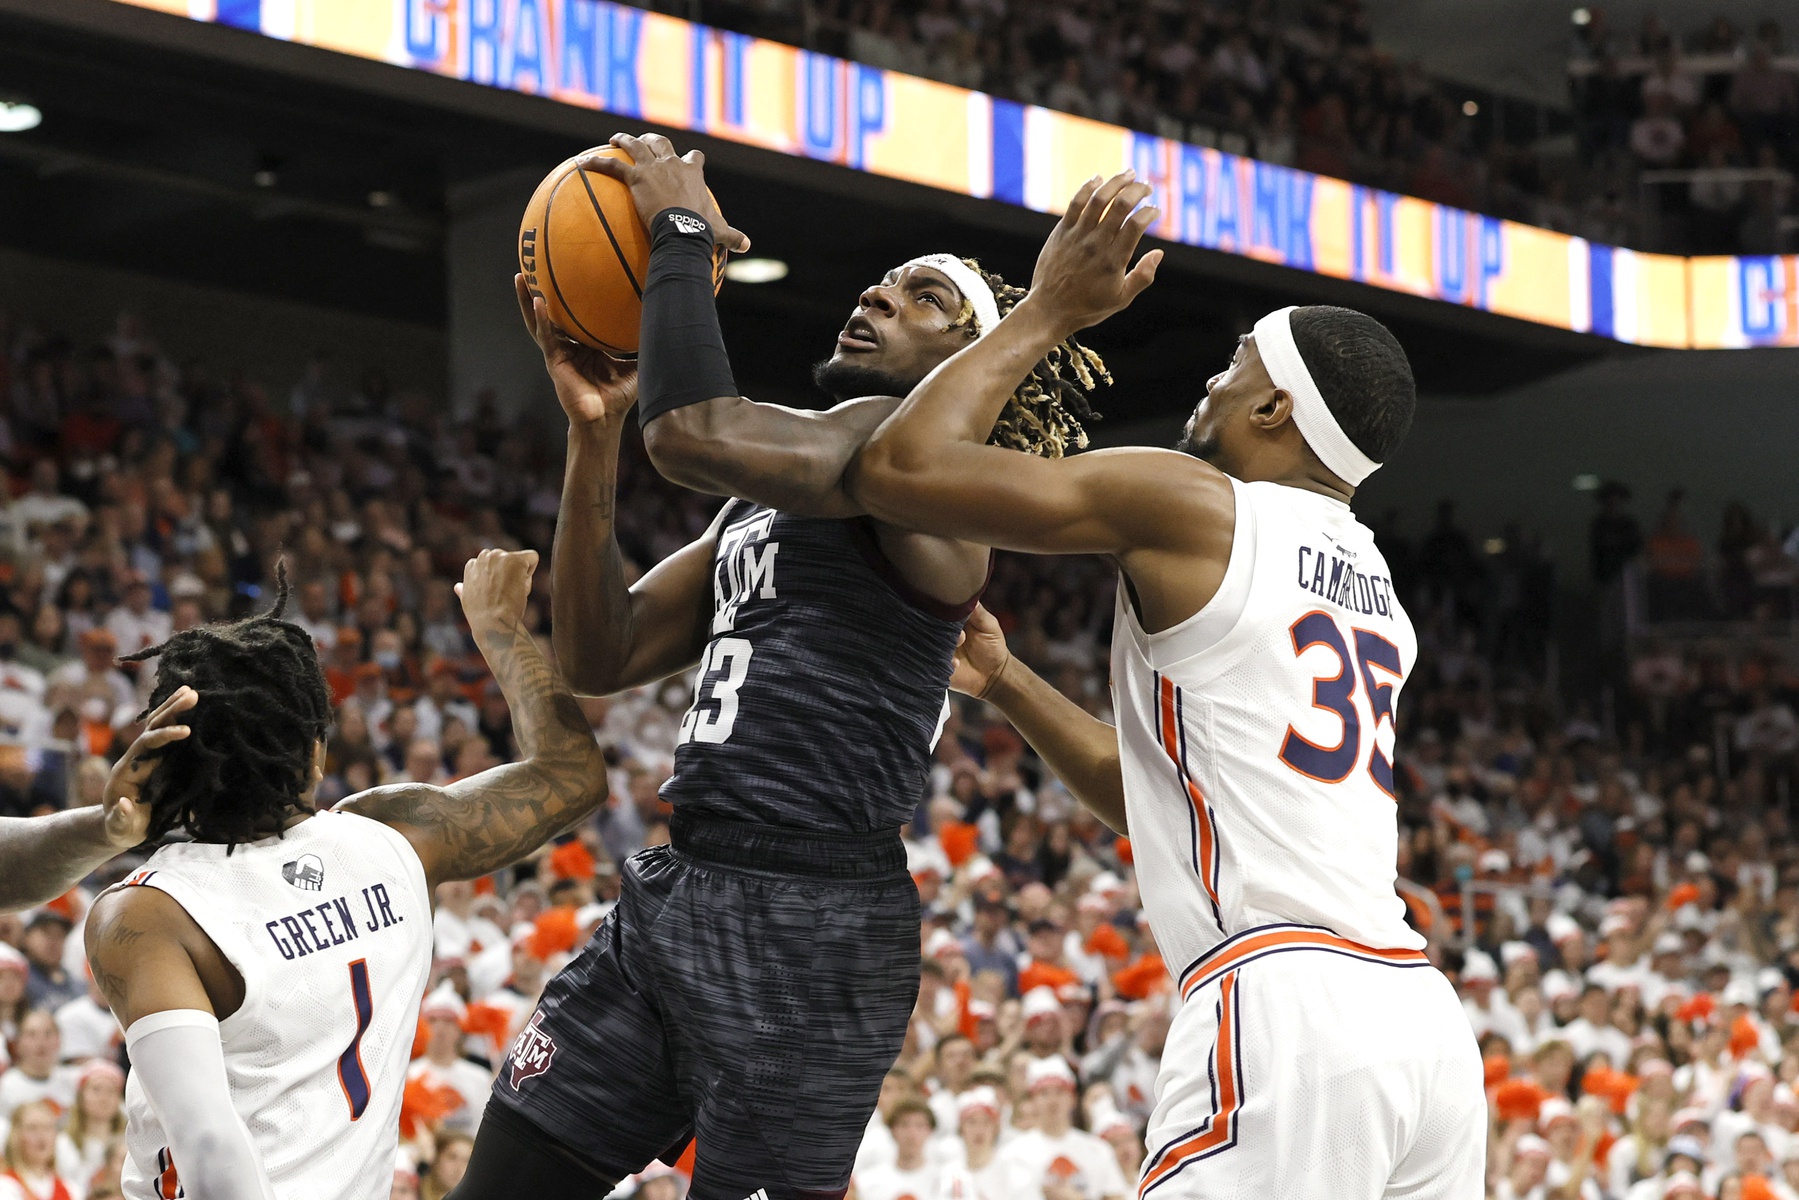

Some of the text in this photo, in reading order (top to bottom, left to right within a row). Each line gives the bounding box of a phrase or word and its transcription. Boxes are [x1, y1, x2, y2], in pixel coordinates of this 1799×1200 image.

[690, 21, 752, 135] IT
[801, 48, 885, 170] UP
[668, 213, 706, 231] adidas
[1132, 129, 1501, 312] CRANK IT UP
[1278, 610, 1403, 801] 35
[265, 883, 404, 960] GREEN JR.
[337, 958, 373, 1122] 1
